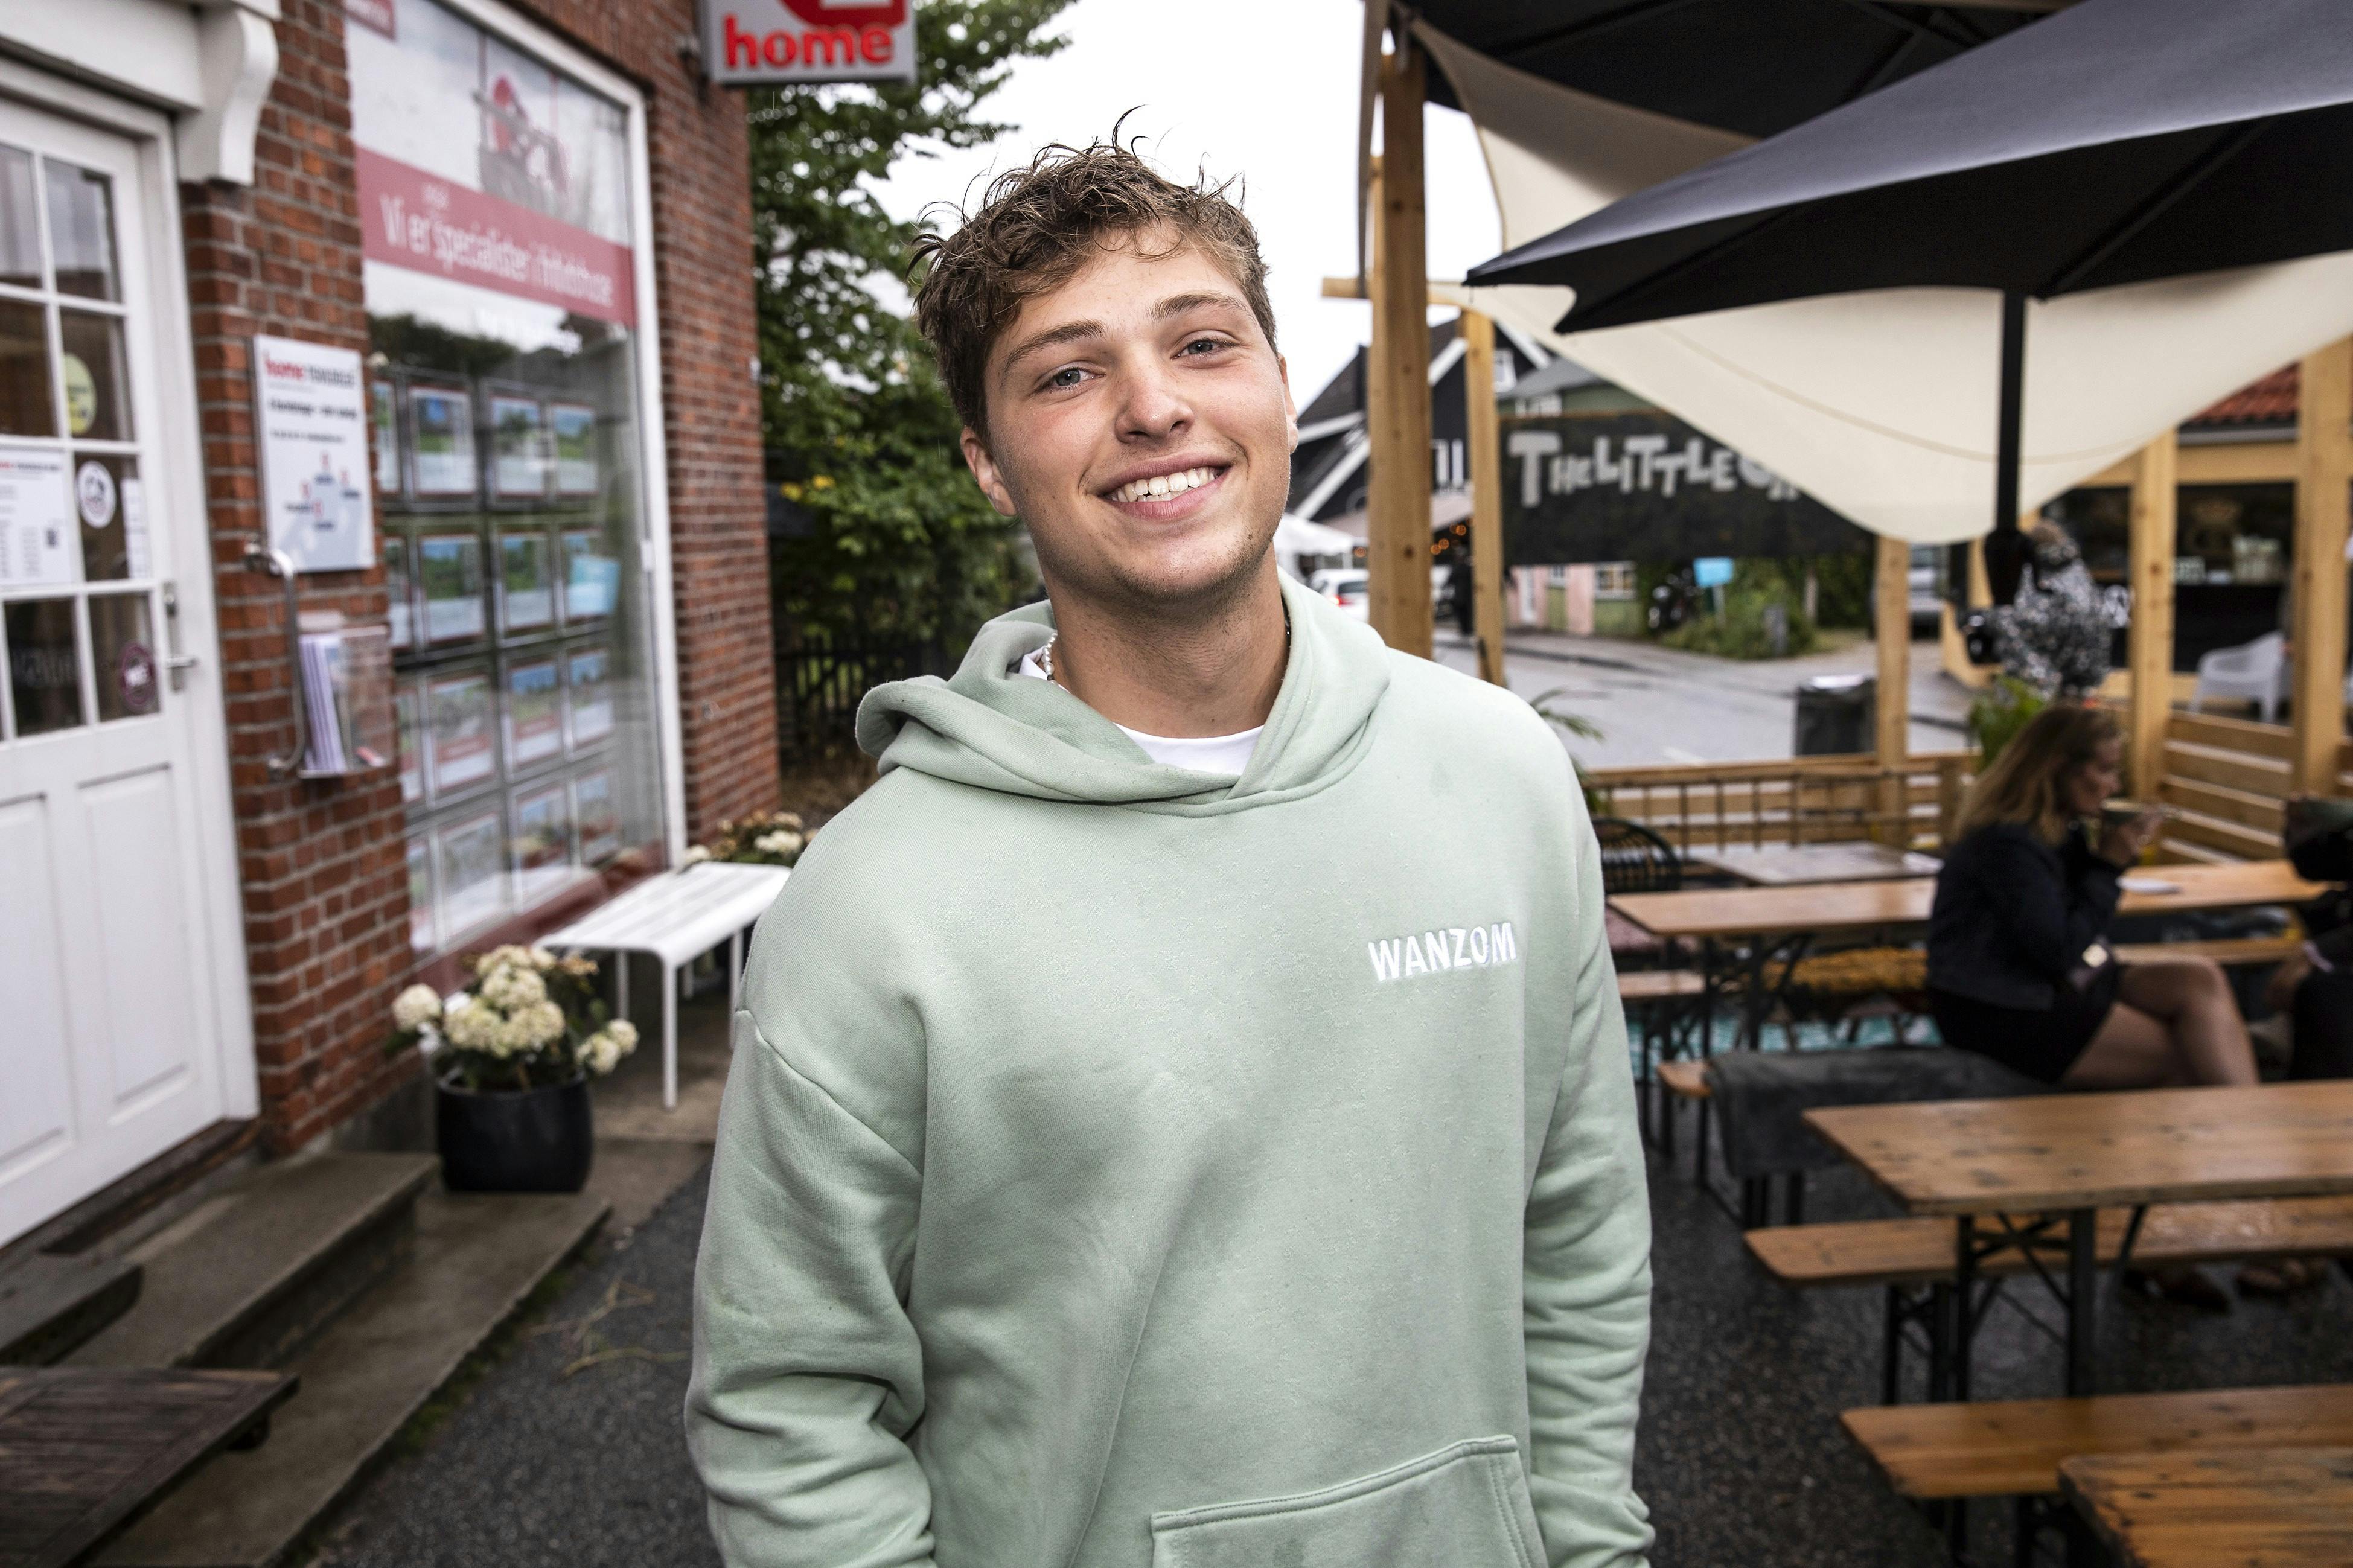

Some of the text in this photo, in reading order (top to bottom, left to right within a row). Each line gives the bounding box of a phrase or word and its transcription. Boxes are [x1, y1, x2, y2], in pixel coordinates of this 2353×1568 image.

[723, 14, 893, 68] home
[409, 213, 431, 257] er
[1367, 922, 1516, 981] WANZOM
